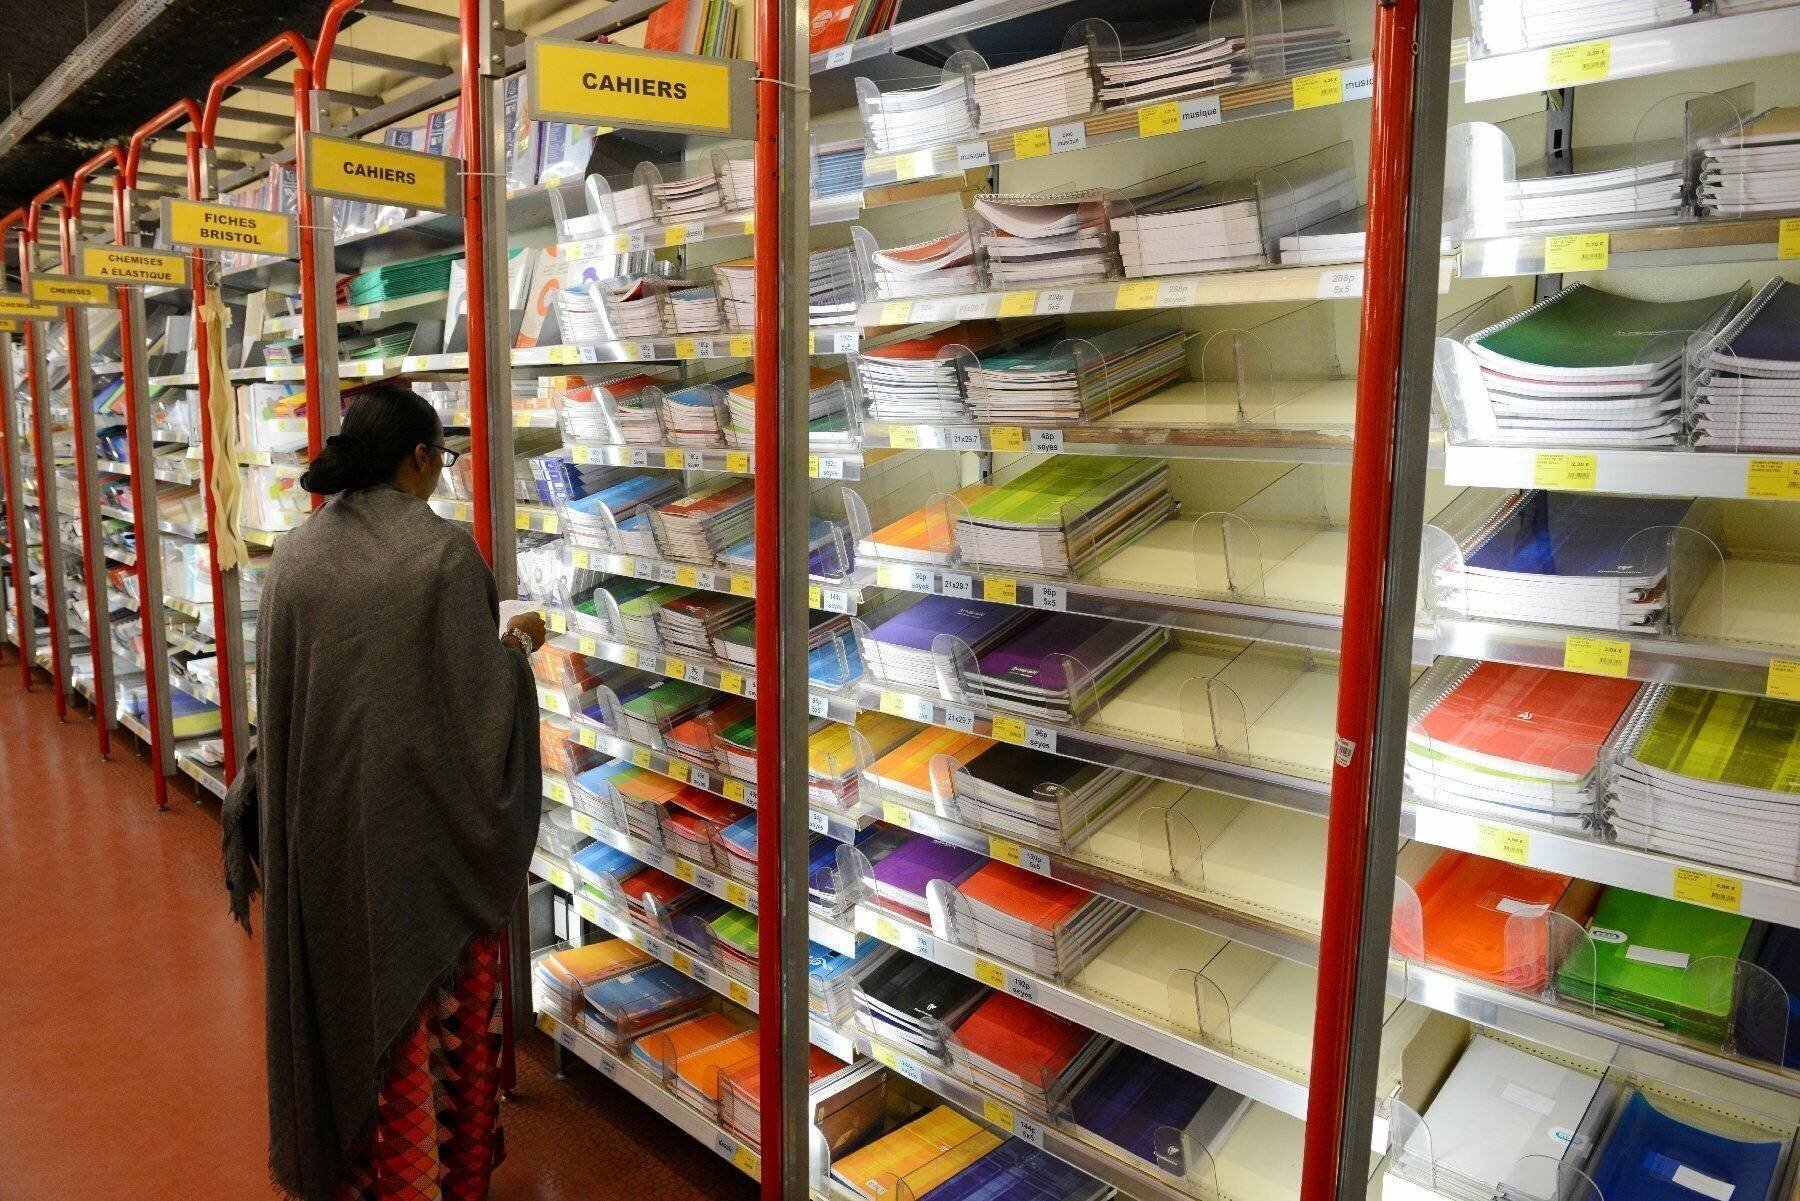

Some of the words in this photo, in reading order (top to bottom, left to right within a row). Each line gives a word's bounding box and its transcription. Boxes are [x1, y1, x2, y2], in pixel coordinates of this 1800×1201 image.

[582, 72, 688, 100] CAHIERS
[1182, 108, 1217, 120] musique
[960, 149, 987, 161] musique
[343, 161, 416, 185] CAHIERS
[204, 212, 257, 229] FICHES
[200, 228, 261, 246] BRISTOL
[108, 253, 163, 266] CHEMISES
[111, 266, 172, 281] ELASTIQUE
[1332, 274, 1355, 284] 288p
[50, 286, 91, 296] CHEMISES
[1333, 285, 1350, 294] 5x5
[1043, 587, 1057, 597] 96p
[1043, 599, 1057, 608] 5x5
[1014, 977, 1031, 990] 192p
[1020, 1120, 1036, 1134] 144p
